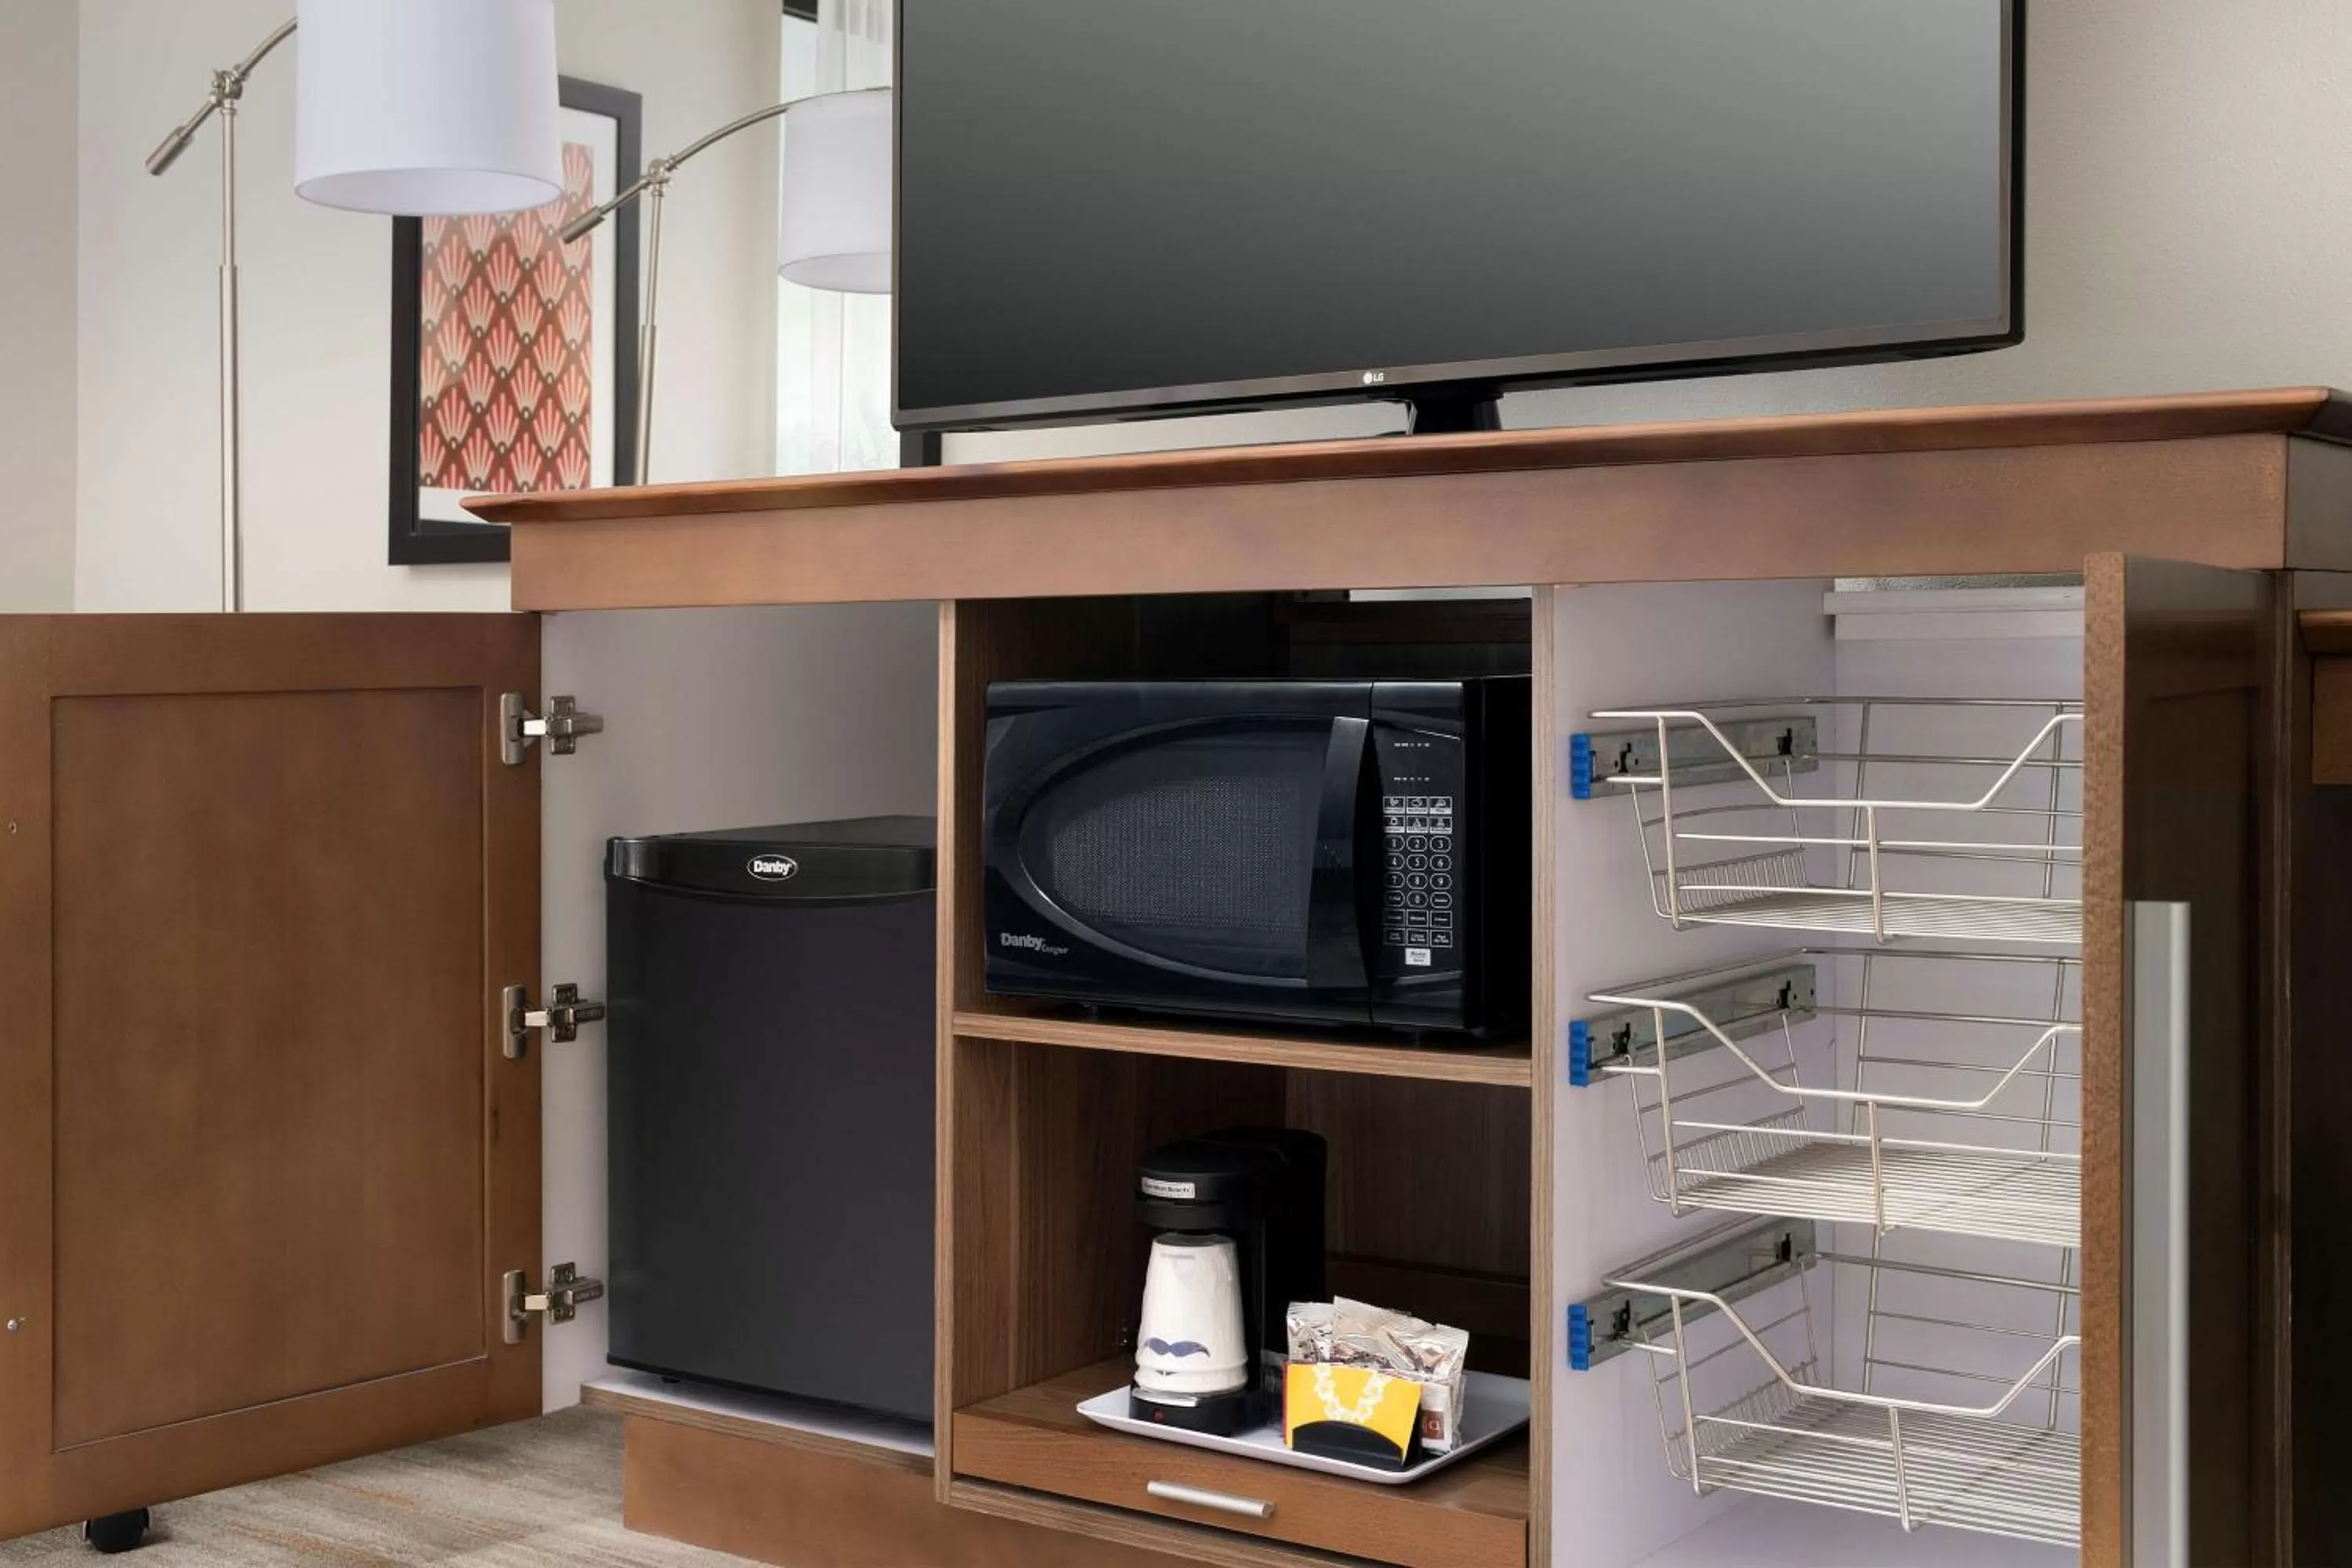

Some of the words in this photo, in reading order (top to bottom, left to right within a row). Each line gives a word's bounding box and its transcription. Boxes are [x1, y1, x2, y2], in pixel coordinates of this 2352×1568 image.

[1373, 372, 1384, 382] LG
[753, 860, 790, 876] Danby
[1000, 933, 1045, 951] Danby
